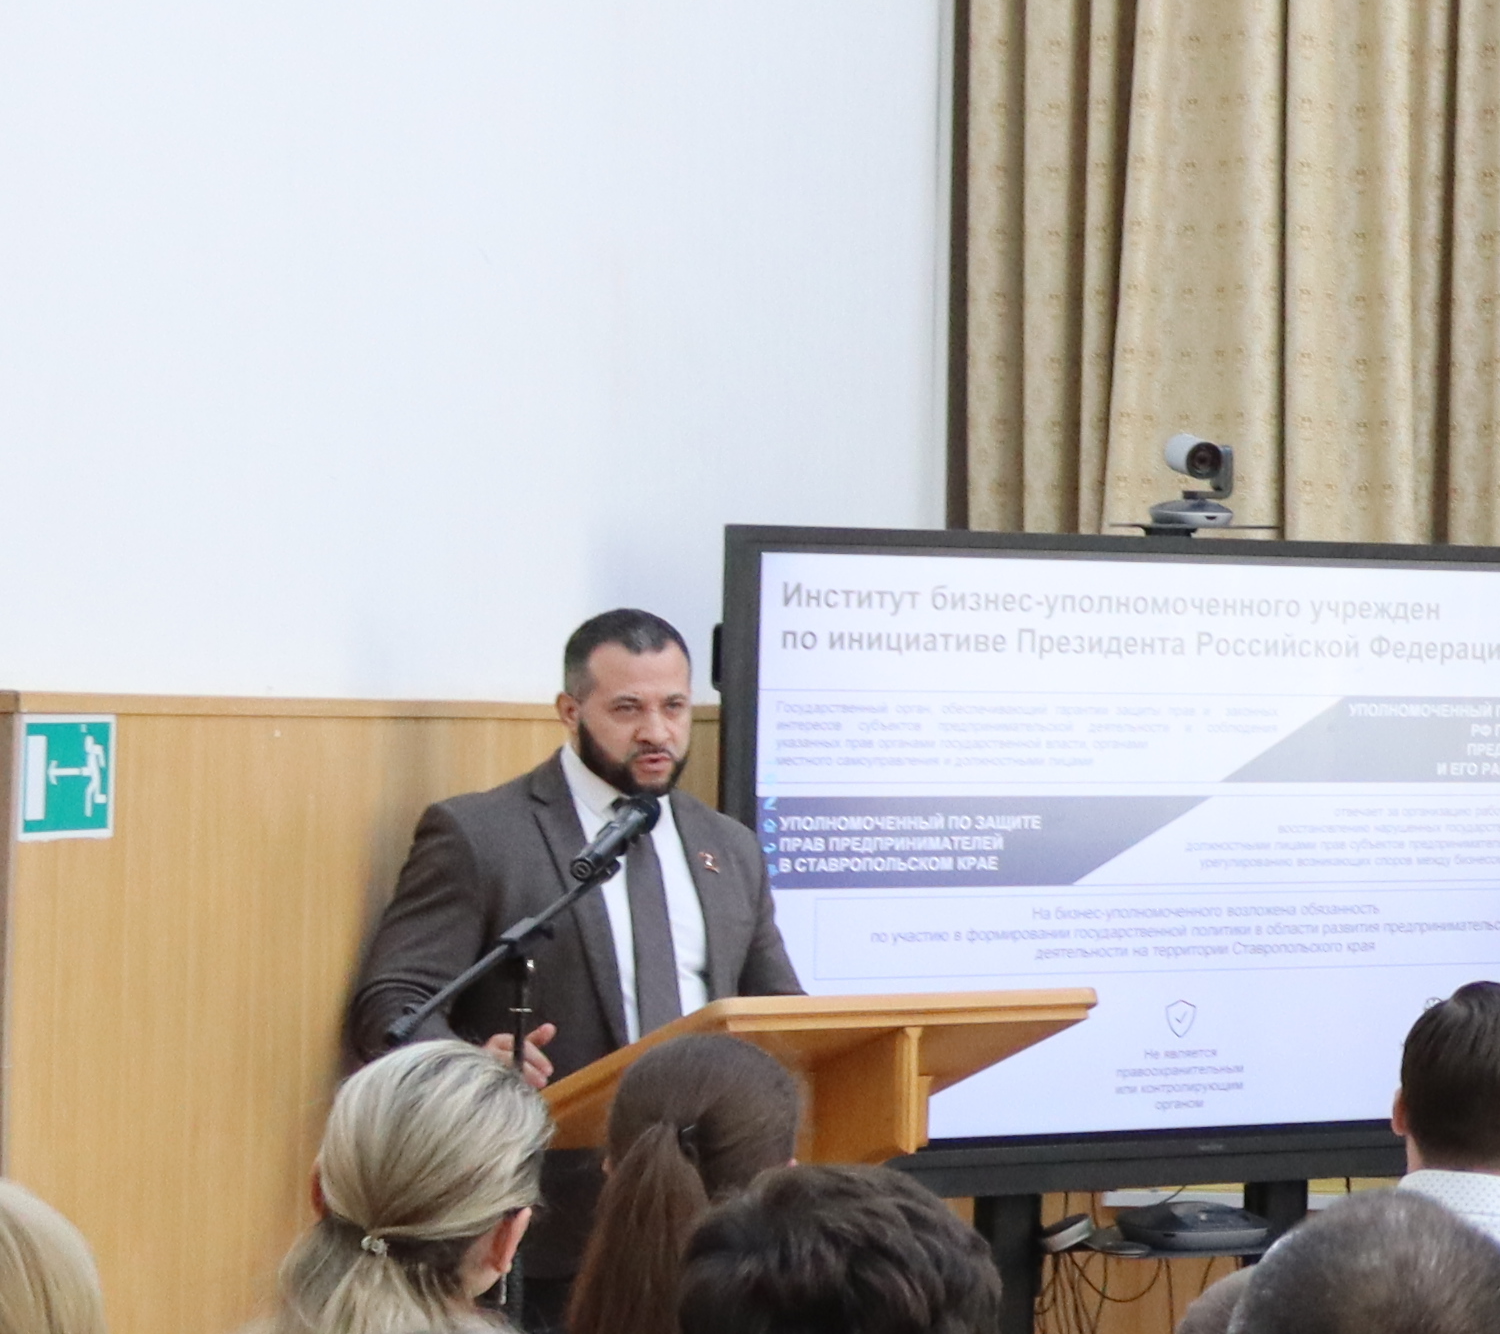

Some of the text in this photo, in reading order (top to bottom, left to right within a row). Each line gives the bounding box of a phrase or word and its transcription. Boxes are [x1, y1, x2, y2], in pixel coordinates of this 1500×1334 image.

[782, 581, 1441, 624] Институт бизнес-уполномоченного учрежден
[781, 629, 817, 651] по
[828, 630, 1006, 655] инициативе
[1017, 628, 1185, 659] Президента
[1197, 631, 1360, 658] Российской
[1348, 701, 1492, 718] УПОЛНОМОЧЕННЫЙ
[1470, 723, 1492, 738] РФ
[1437, 762, 1447, 776] И
[1450, 762, 1478, 776] ЕГО
[779, 812, 1042, 833] УПОЛНОМОЧЕННЫЙ ПО ЗАЩИТЕ
[779, 833, 1004, 854] ПРАВ ПРЕДПРИНИМАТЕЛЕЙ
[779, 855, 1000, 872] В СТАВРОПОЛЬСКОМ КРАЕ
[1032, 901, 1380, 922] На бизнес-уполномоченного возложена обязанность
[870, 932, 888, 943] по
[891, 930, 950, 946] участию
[953, 931, 962, 942] в
[965, 927, 1070, 944] формировании
[1073, 924, 1187, 940] государственной
[1191, 925, 1251, 937] политики
[1254, 925, 1262, 936] в
[1266, 922, 1319, 936] области
[1322, 922, 1380, 938] развития
[1034, 941, 1376, 960] деятельности на территории Ставропольского края
[1144, 1048, 1217, 1060] Не является
[1115, 1081, 1244, 1095] или контролирующим
[1154, 1099, 1205, 1111] органом
